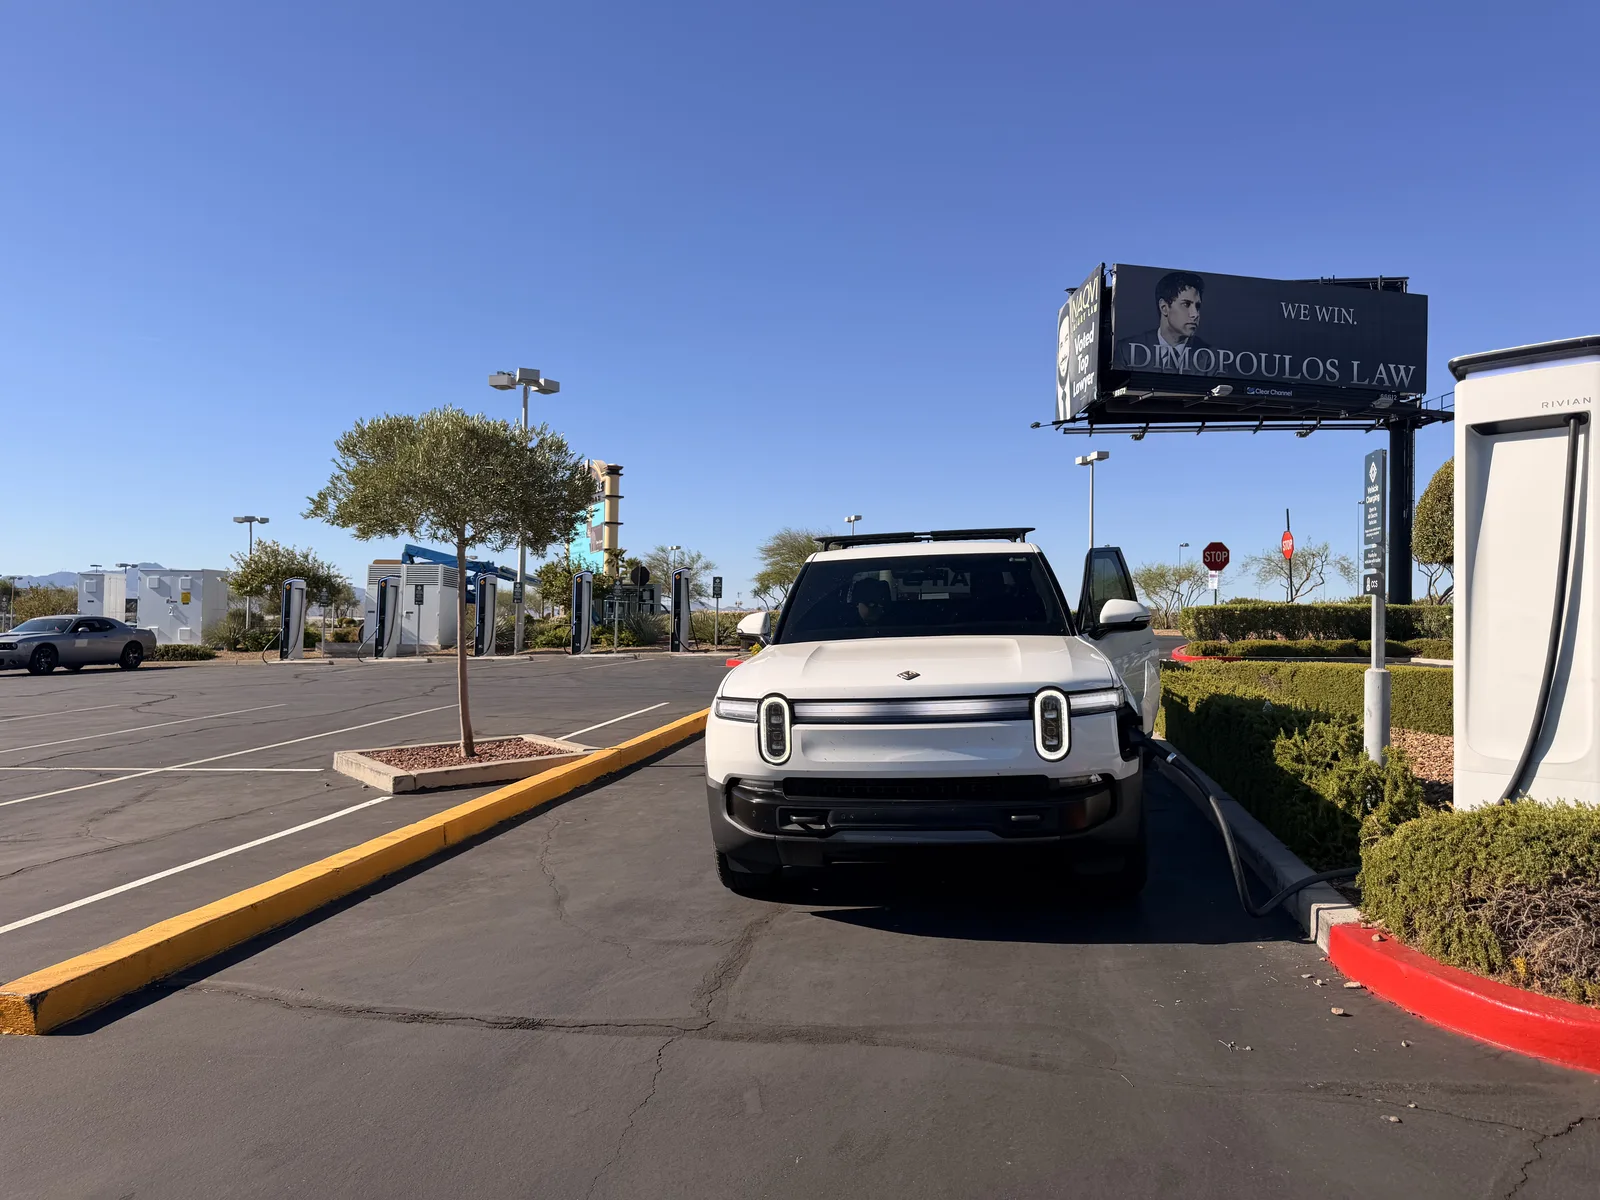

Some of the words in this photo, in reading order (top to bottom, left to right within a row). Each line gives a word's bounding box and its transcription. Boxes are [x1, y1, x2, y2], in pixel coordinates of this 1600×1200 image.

[1071, 276, 1098, 323] NAQVI
[1280, 302, 1310, 320] WE
[1314, 305, 1357, 325] WIN.
[1074, 321, 1095, 356] Voted
[1078, 353, 1089, 375] Top
[1128, 342, 1340, 382] DIMOPOULOS
[1351, 360, 1416, 389] LAW
[1073, 371, 1095, 398] Lawyer
[1270, 389, 1293, 397] Channel
[1541, 396, 1592, 409] RIVIAN
[1281, 539, 1293, 551] STOP
[1204, 551, 1229, 563] STOP
